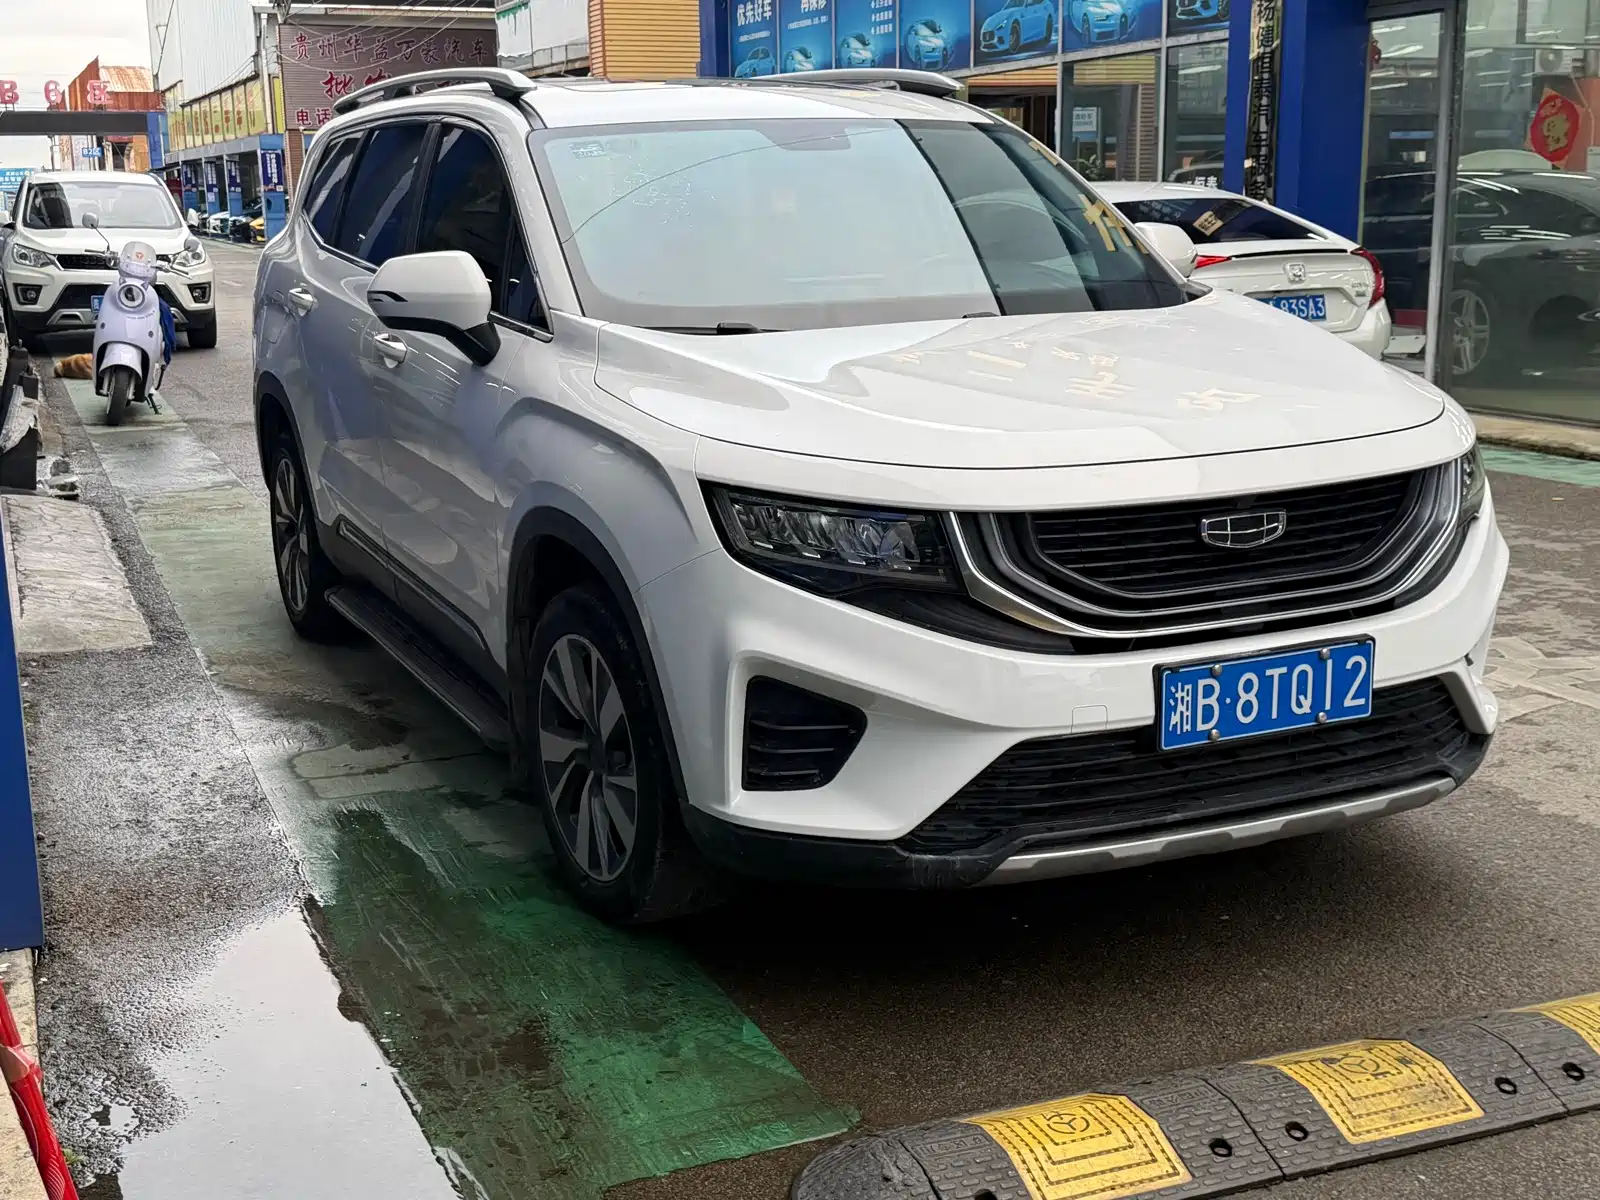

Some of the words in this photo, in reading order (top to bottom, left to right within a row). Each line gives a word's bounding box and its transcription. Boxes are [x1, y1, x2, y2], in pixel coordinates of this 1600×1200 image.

[291, 33, 497, 65] 贵州华益万豪汽车
[295, 108, 332, 126] 电话
[1269, 297, 1325, 318] 83SA3
[1168, 655, 1367, 735] 湘B·8TQ12
